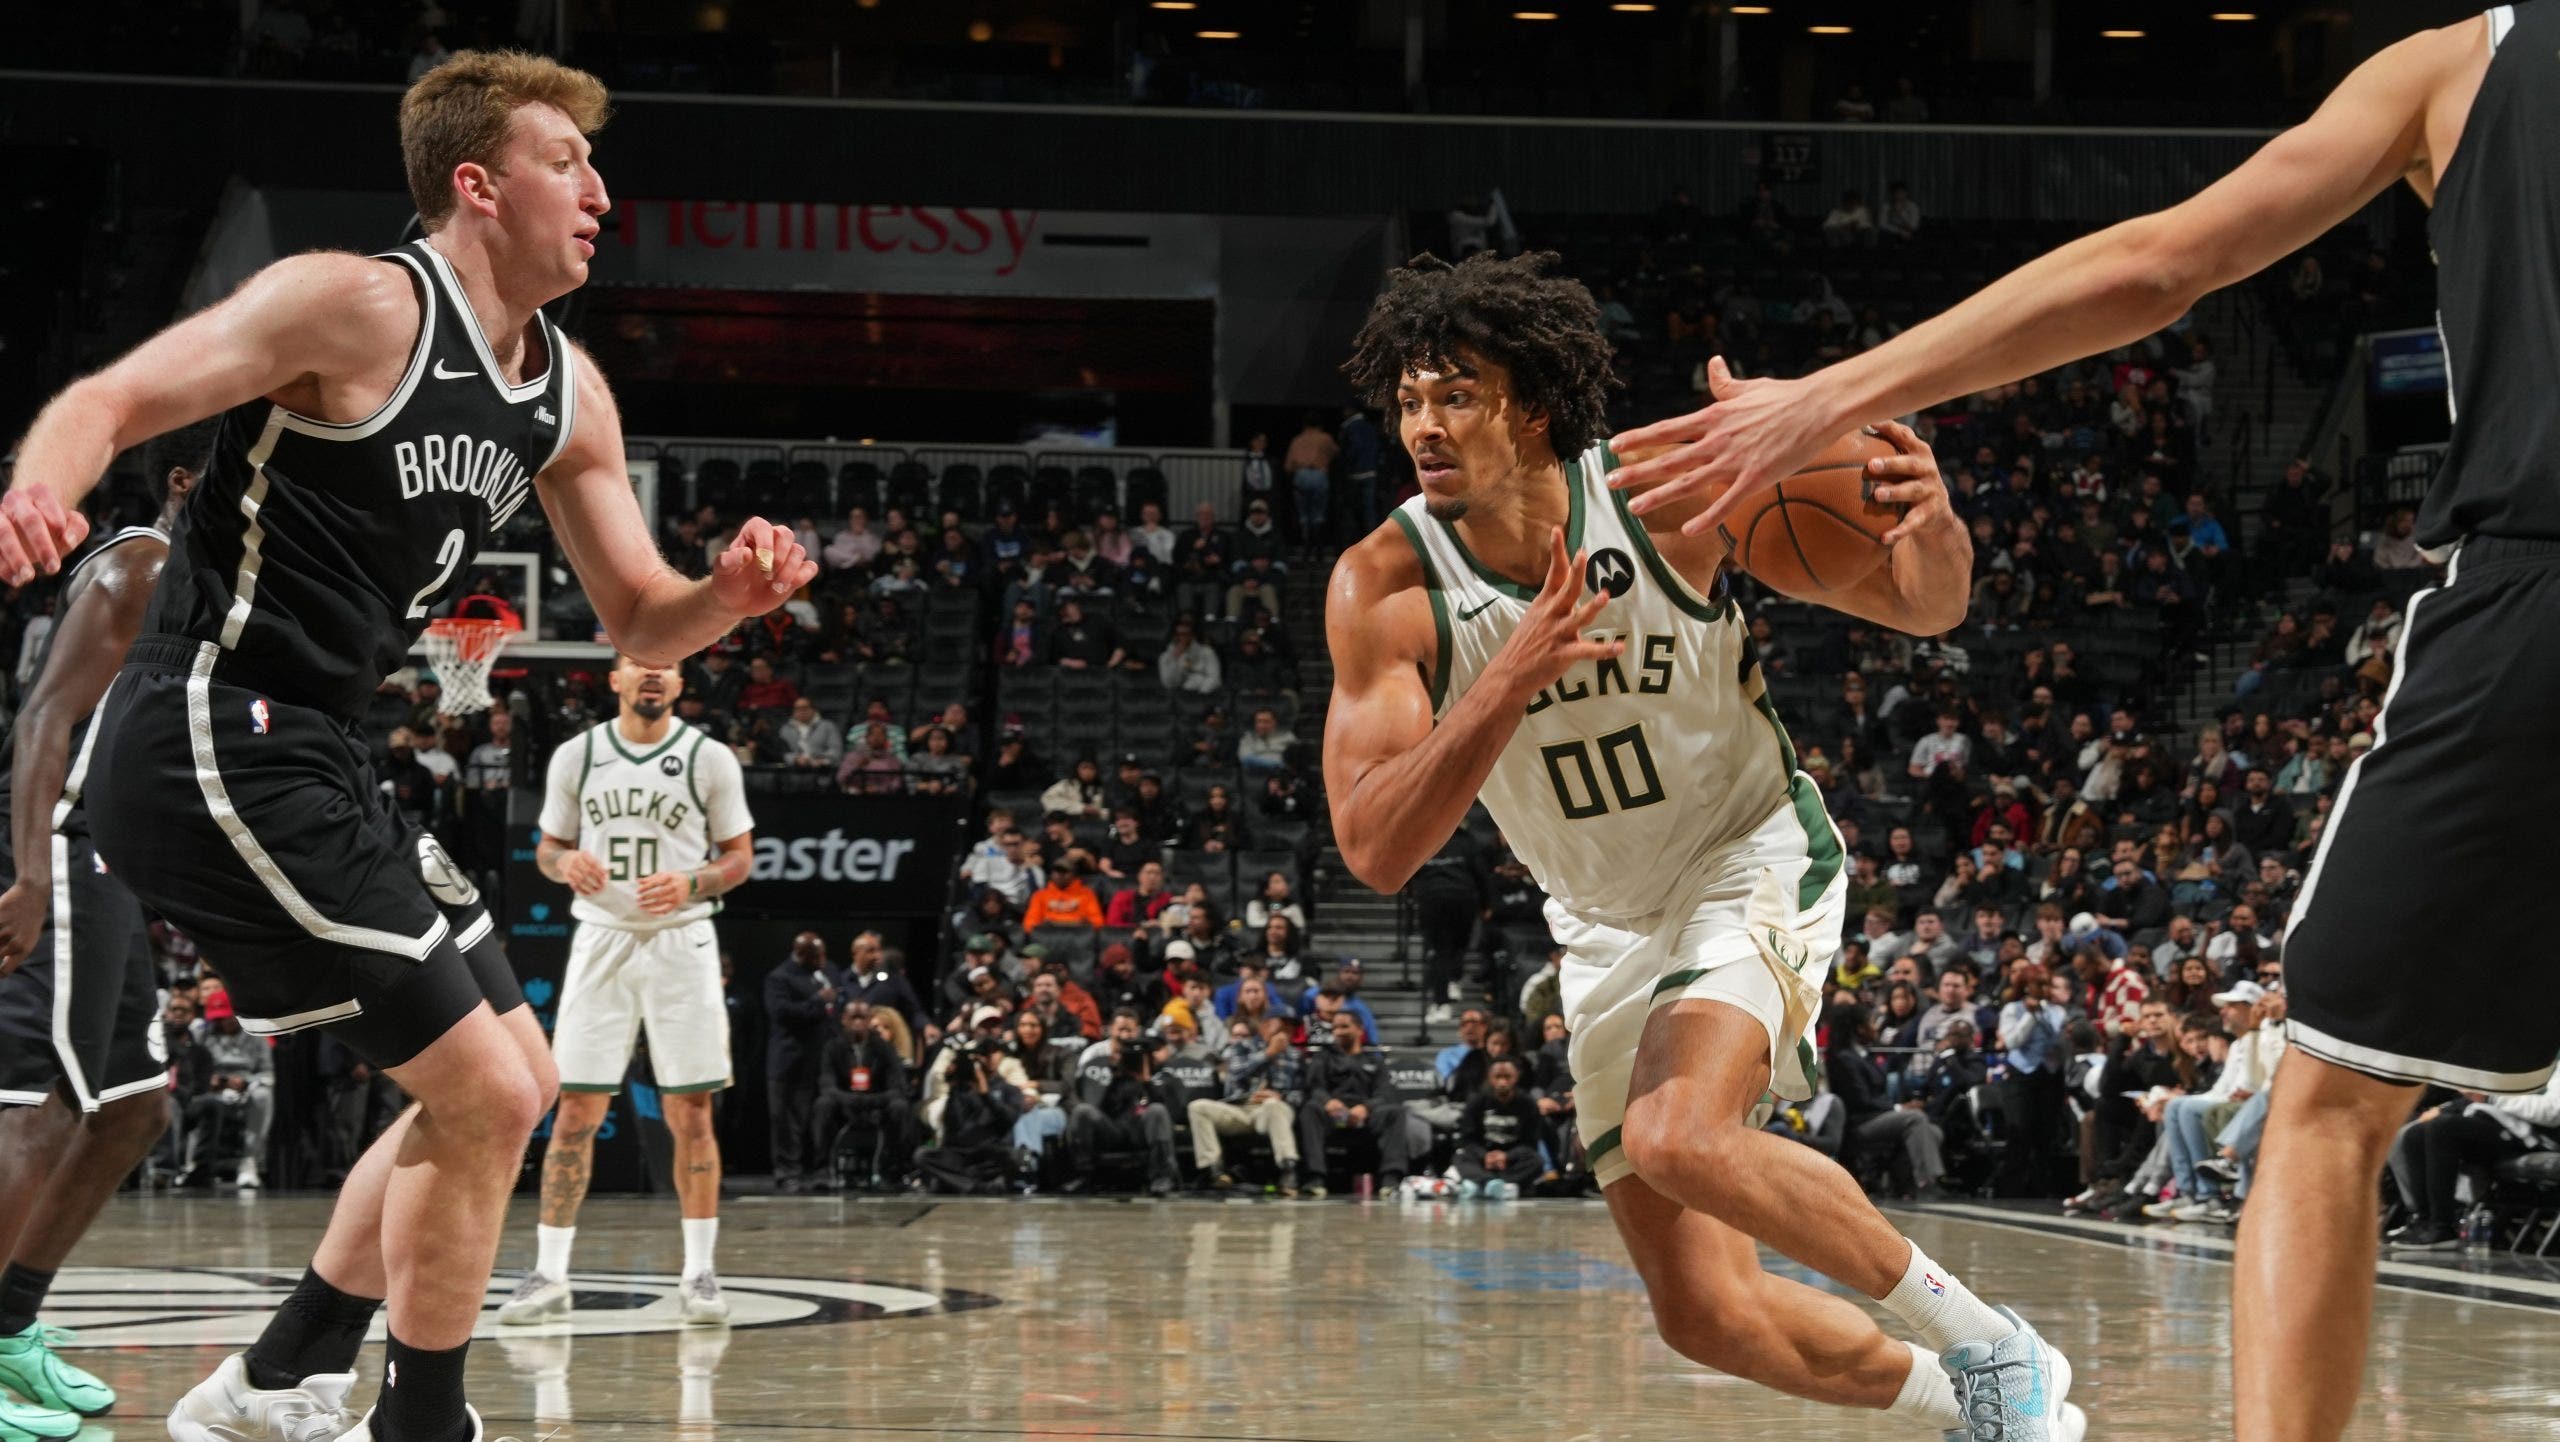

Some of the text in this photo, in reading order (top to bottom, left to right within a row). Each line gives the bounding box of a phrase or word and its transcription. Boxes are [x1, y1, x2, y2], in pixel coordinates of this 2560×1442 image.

[405, 528, 465, 619] 2
[1538, 722, 1667, 820] 00
[585, 787, 689, 831] BUCKS
[608, 837, 658, 881] 50
[751, 828, 915, 882] aster
